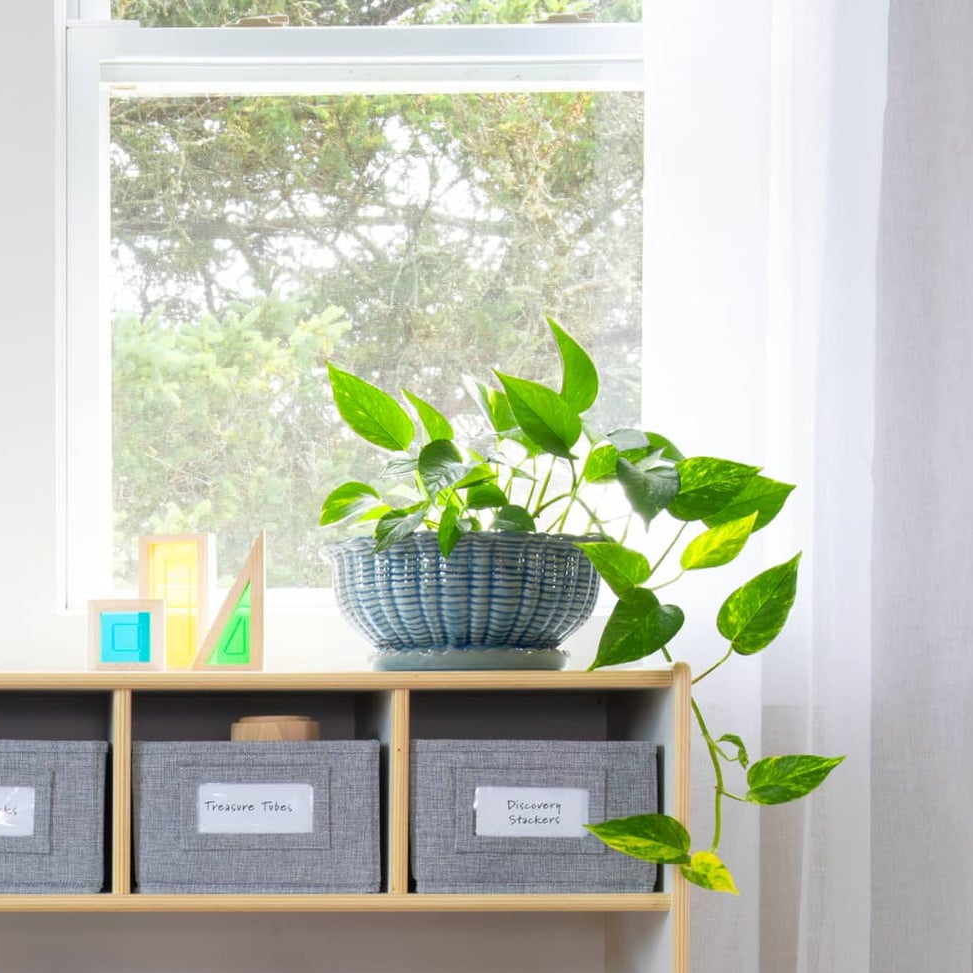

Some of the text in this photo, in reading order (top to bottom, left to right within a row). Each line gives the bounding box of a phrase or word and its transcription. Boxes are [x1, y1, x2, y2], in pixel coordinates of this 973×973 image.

[205, 801, 293, 812] Treasure Tubes
[507, 800, 561, 814] Discovery
[509, 815, 560, 825] Stackers
